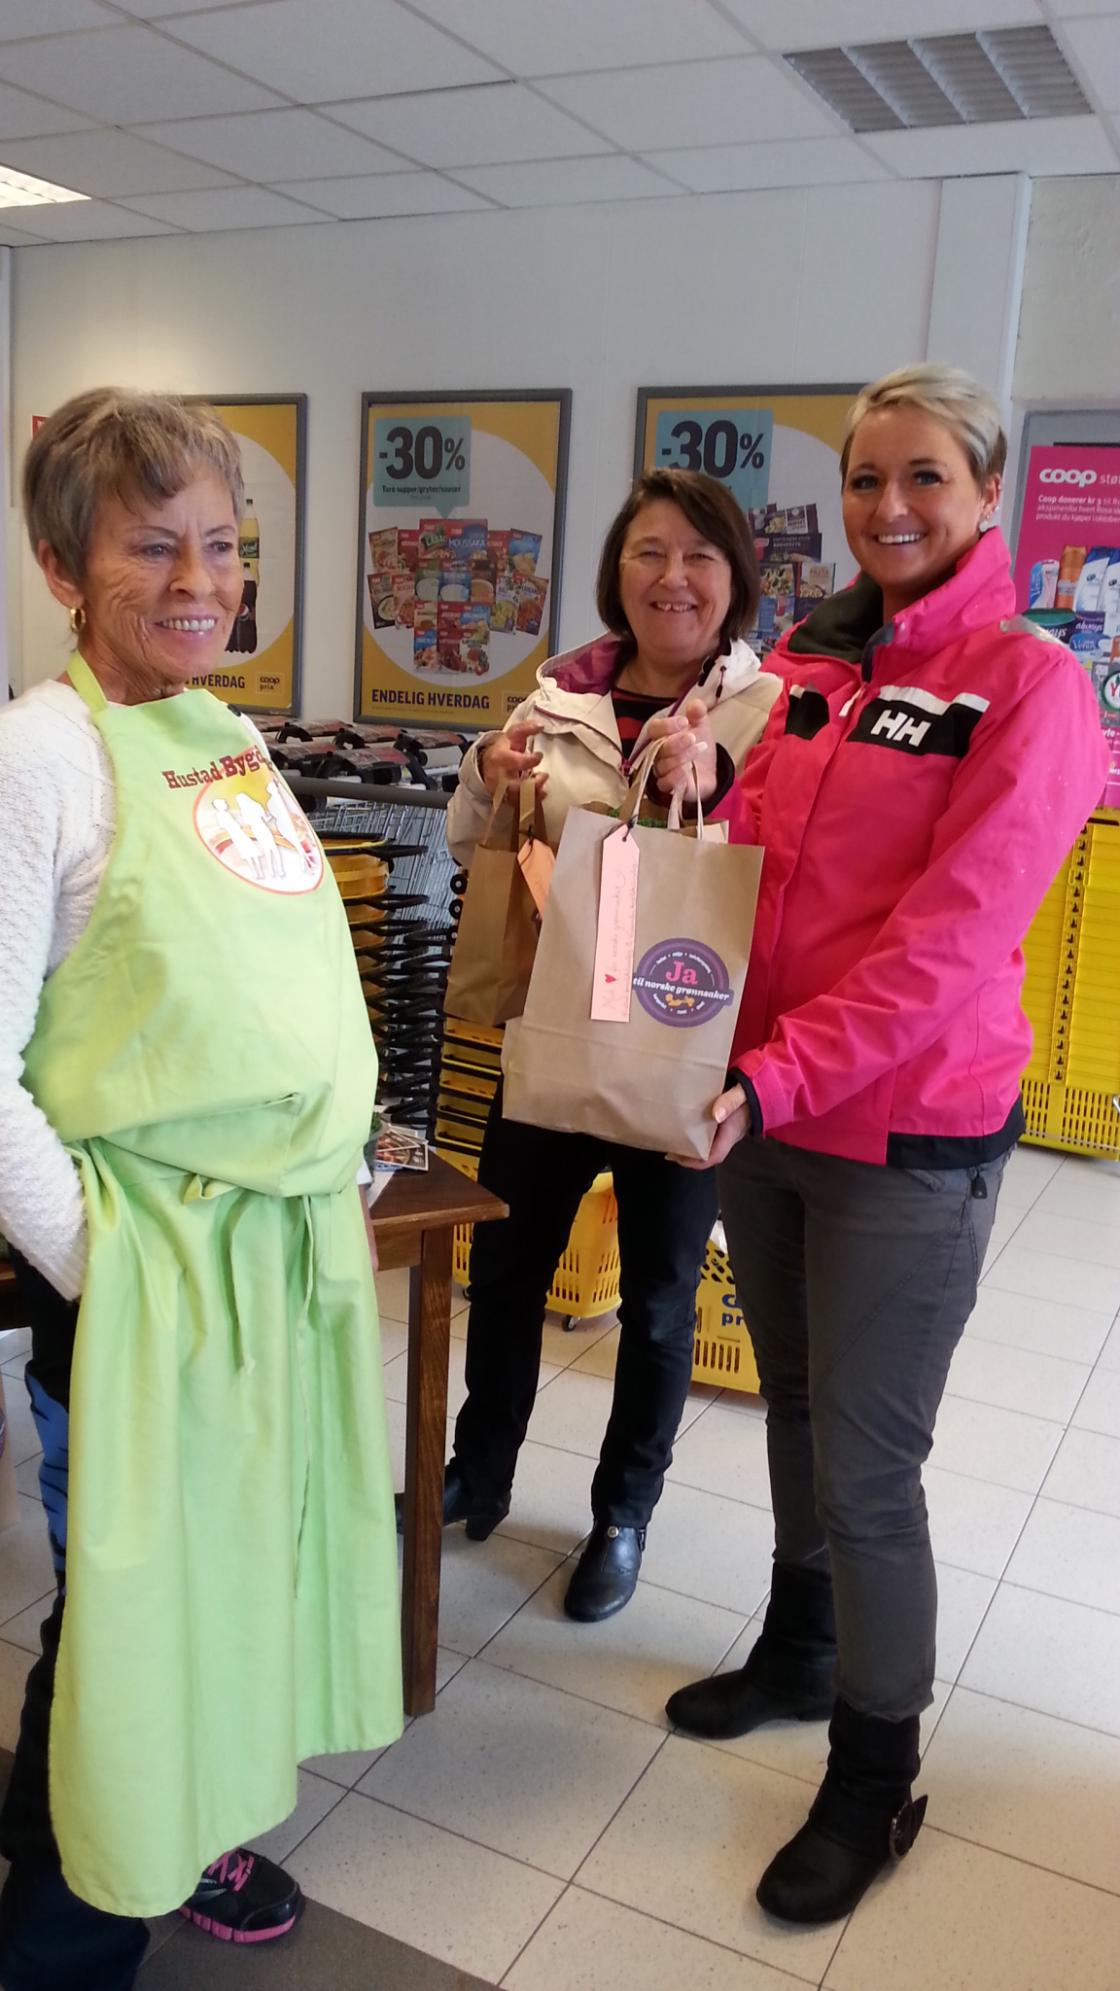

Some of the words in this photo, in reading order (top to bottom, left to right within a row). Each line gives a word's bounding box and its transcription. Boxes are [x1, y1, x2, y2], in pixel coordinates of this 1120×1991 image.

[379, 426, 465, 480] -30%
[662, 420, 764, 478] -30%
[1040, 468, 1097, 488] coop
[1038, 495, 1057, 503] Coop
[372, 689, 425, 705] ENDELIG
[428, 693, 490, 709] HVERDAG
[870, 709, 932, 747] HH
[162, 761, 223, 789] Hustad
[665, 960, 698, 985] Ja
[633, 977, 645, 987] til
[645, 980, 675, 993] norske
[675, 985, 730, 1001] grønnsaker
